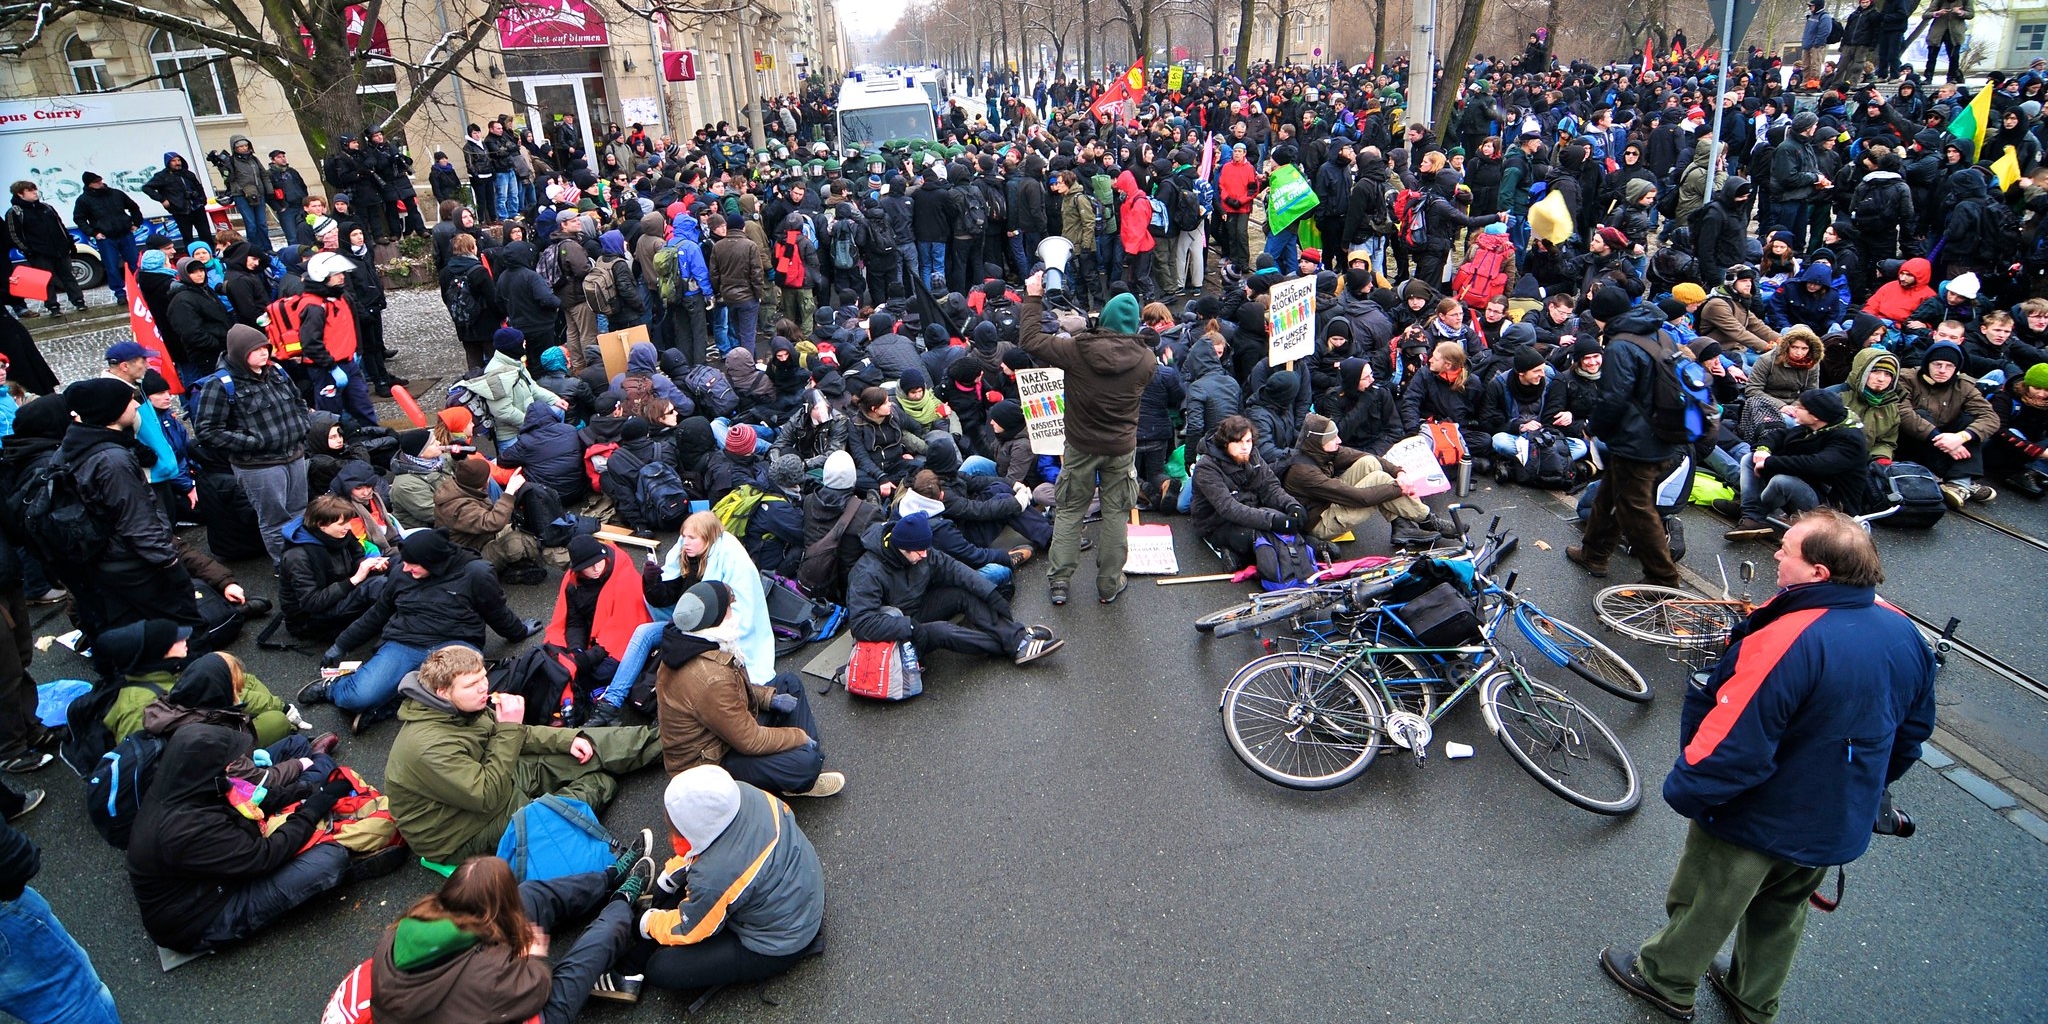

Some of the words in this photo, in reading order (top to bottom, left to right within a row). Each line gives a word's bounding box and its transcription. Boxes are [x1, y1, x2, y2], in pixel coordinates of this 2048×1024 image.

[552, 33, 568, 44] auf
[569, 34, 601, 42] blumen
[33, 109, 82, 120] Curry
[1271, 283, 1313, 313] BLOCKIEREN
[1274, 284, 1295, 302] NAZIS
[1273, 336, 1284, 348] IST
[1285, 323, 1308, 341] UNSER
[1283, 332, 1307, 350] RECHT
[1021, 371, 1049, 385] NAZIS
[1021, 379, 1065, 397] BLOCKIERE
[1030, 418, 1065, 431] RASSISTE
